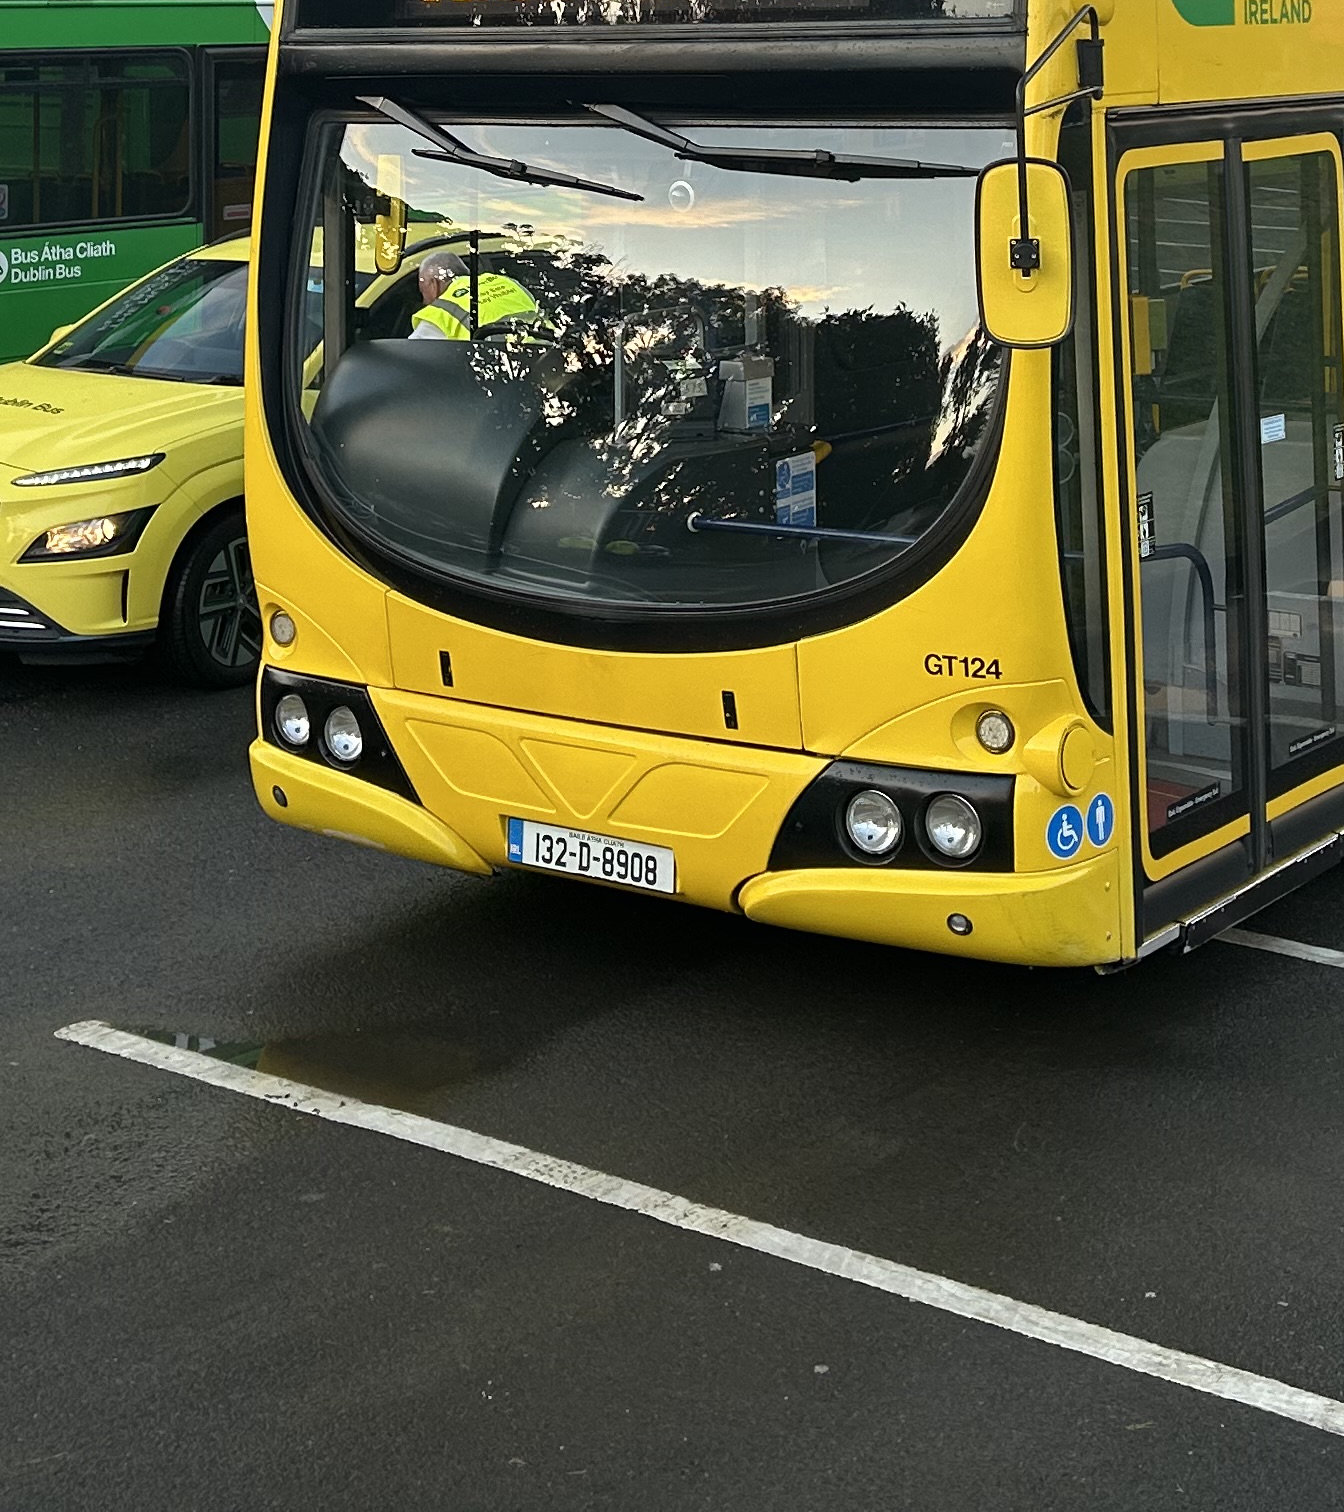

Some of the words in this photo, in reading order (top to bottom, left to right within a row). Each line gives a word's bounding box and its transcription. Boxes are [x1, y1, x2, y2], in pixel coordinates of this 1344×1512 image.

[11, 248, 39, 265] Bus
[40, 242, 74, 263] Átha
[76, 240, 116, 259] Cliath
[11, 266, 53, 284] Dublin
[55, 264, 82, 280] Bus
[924, 653, 1003, 680] GT124
[535, 833, 657, 886] 132-D-8908
